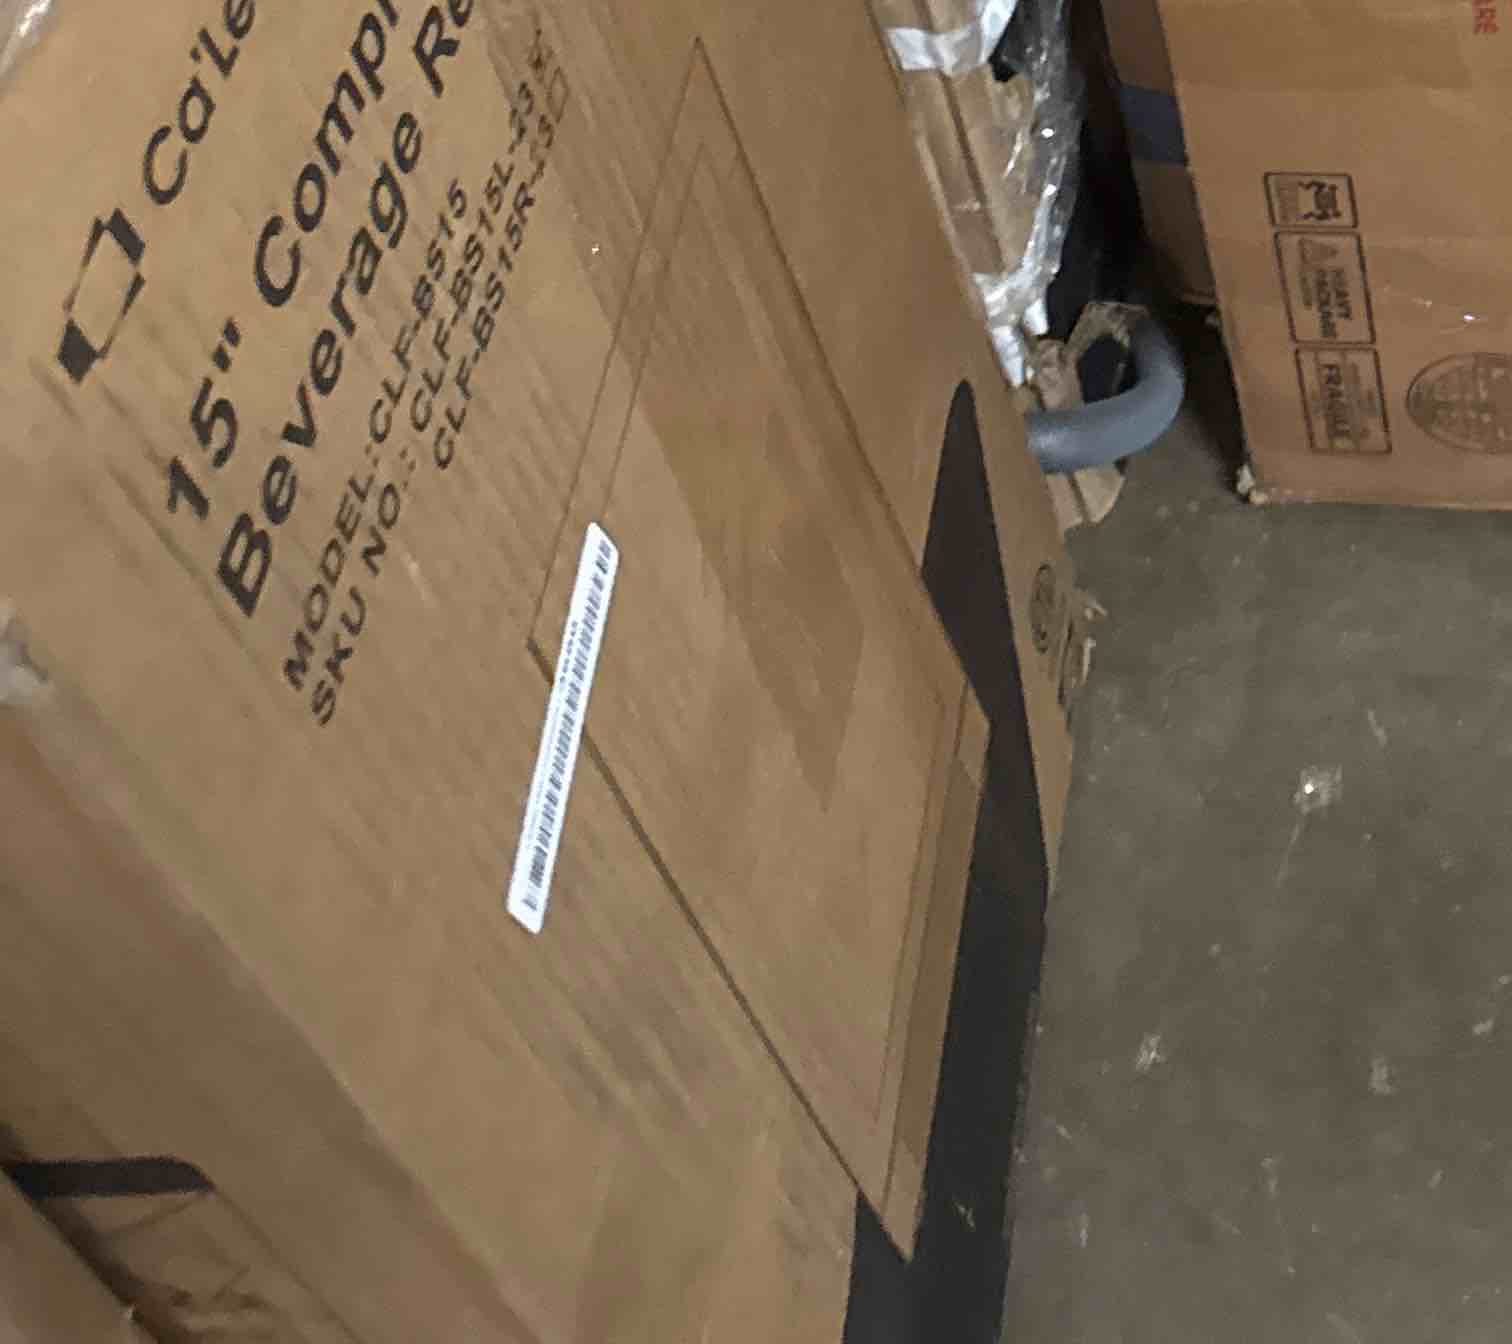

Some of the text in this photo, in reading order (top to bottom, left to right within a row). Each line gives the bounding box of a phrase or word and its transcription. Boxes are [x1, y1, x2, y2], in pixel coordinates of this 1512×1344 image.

[165, 317, 248, 525] 15"
[217, 108, 423, 618] Beverage
[1321, 363, 1350, 441] FRAGILE
[308, 589, 369, 729] SKU
